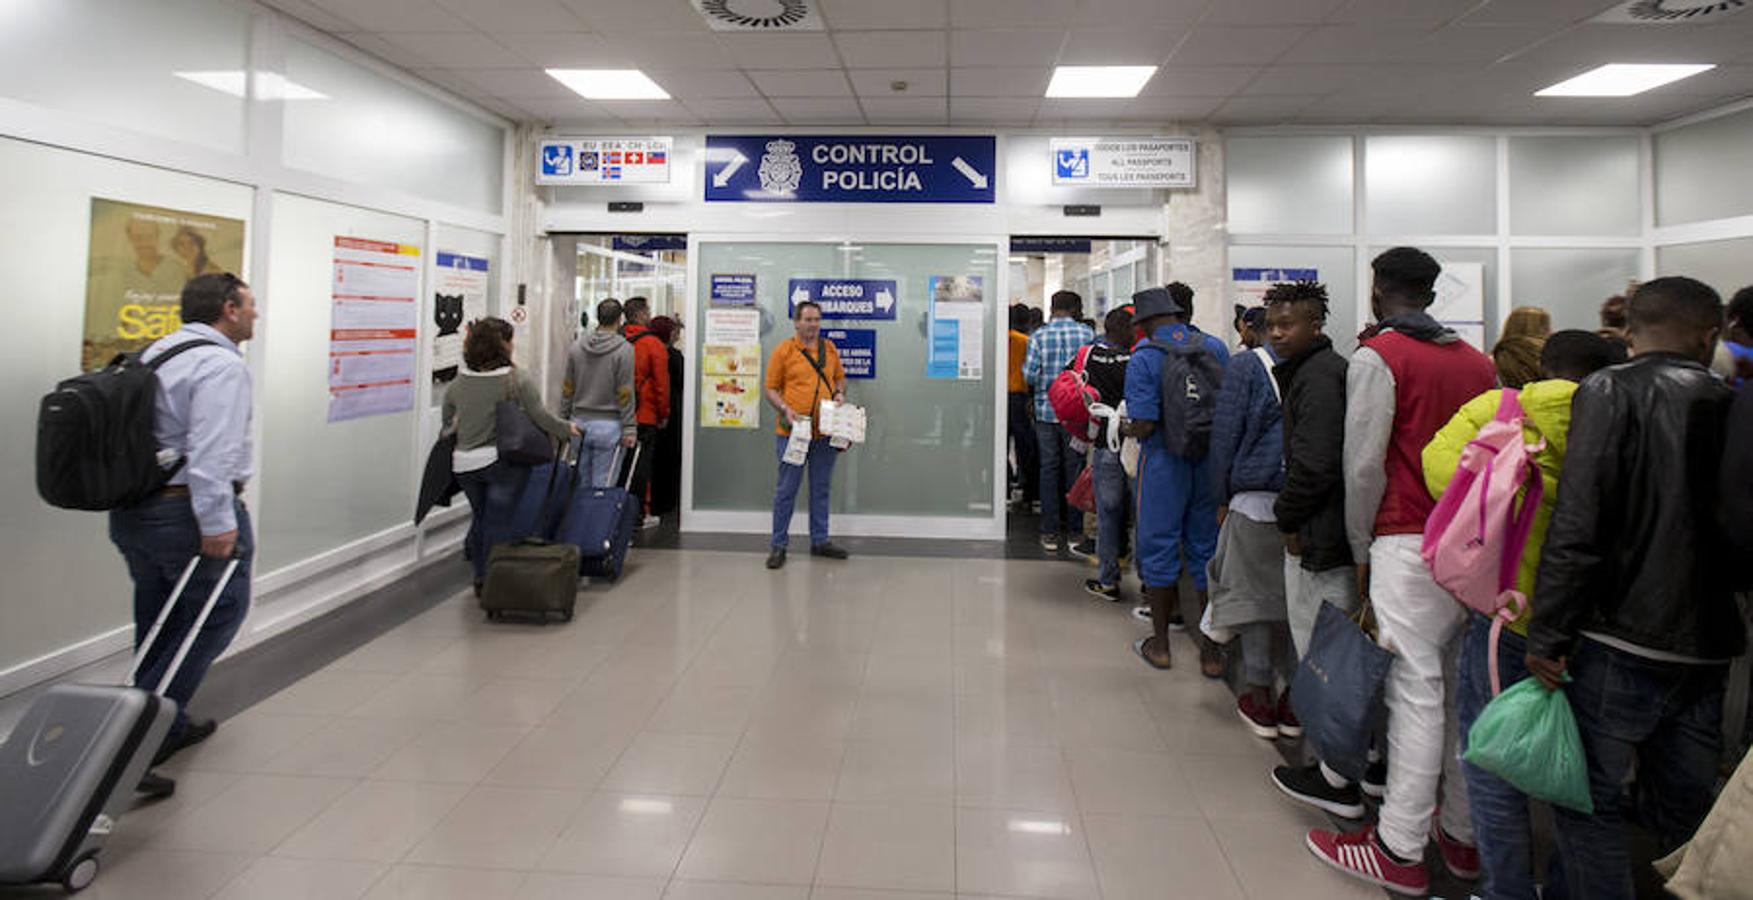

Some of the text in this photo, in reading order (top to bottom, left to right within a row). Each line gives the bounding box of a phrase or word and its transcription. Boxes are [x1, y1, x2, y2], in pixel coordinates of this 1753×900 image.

[812, 143, 933, 165] CONTROL
[1138, 143, 1189, 152] PASAPORTES
[1127, 158, 1172, 166] PASSPORTS
[822, 167, 922, 190] POLICÍA
[821, 284, 864, 297] ACCESO
[817, 301, 873, 314] MBARQUES
